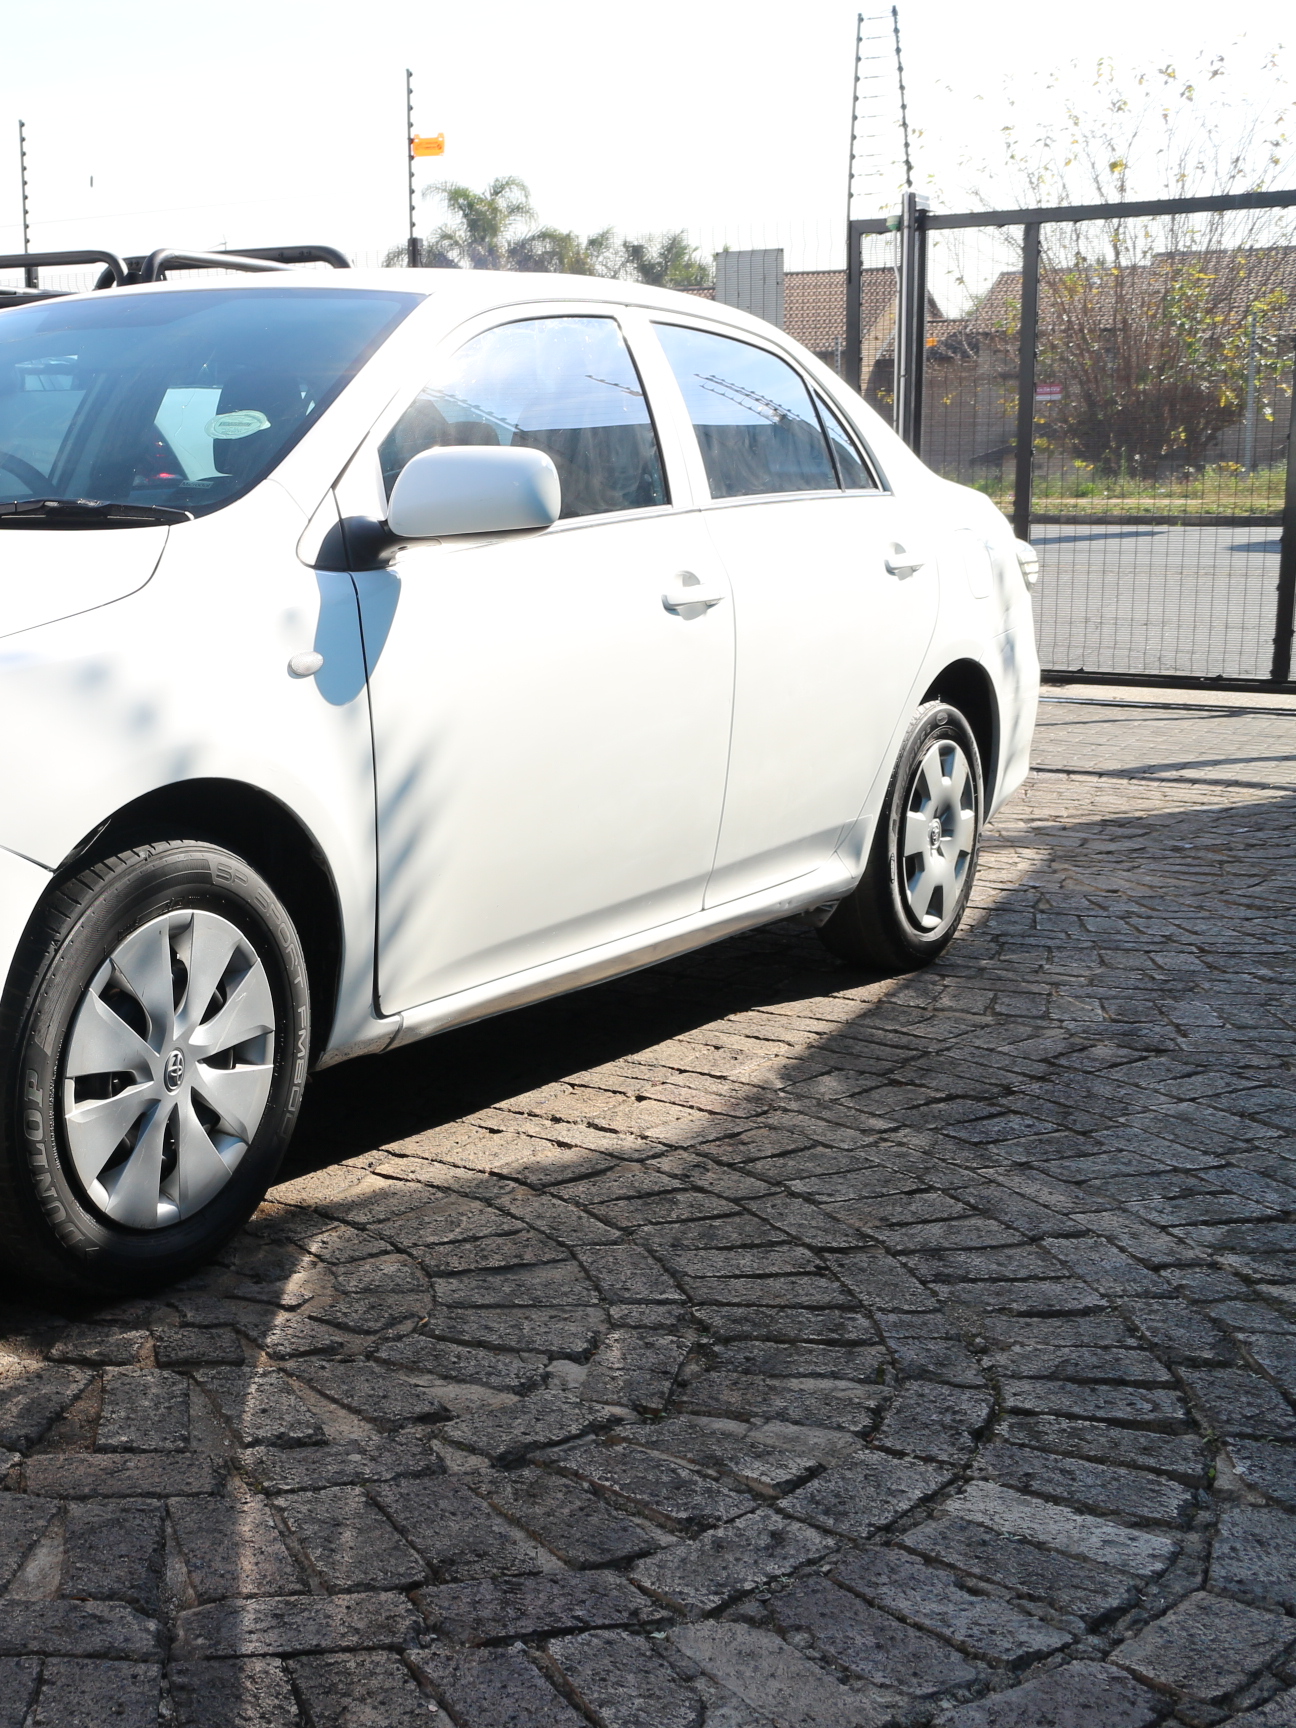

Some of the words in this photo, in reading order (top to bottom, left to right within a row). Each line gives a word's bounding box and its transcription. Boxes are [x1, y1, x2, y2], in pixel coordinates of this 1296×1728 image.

[215, 862, 249, 887] SP
[254, 887, 304, 988] SPORT
[23, 1068, 86, 1248] DUNLOP
